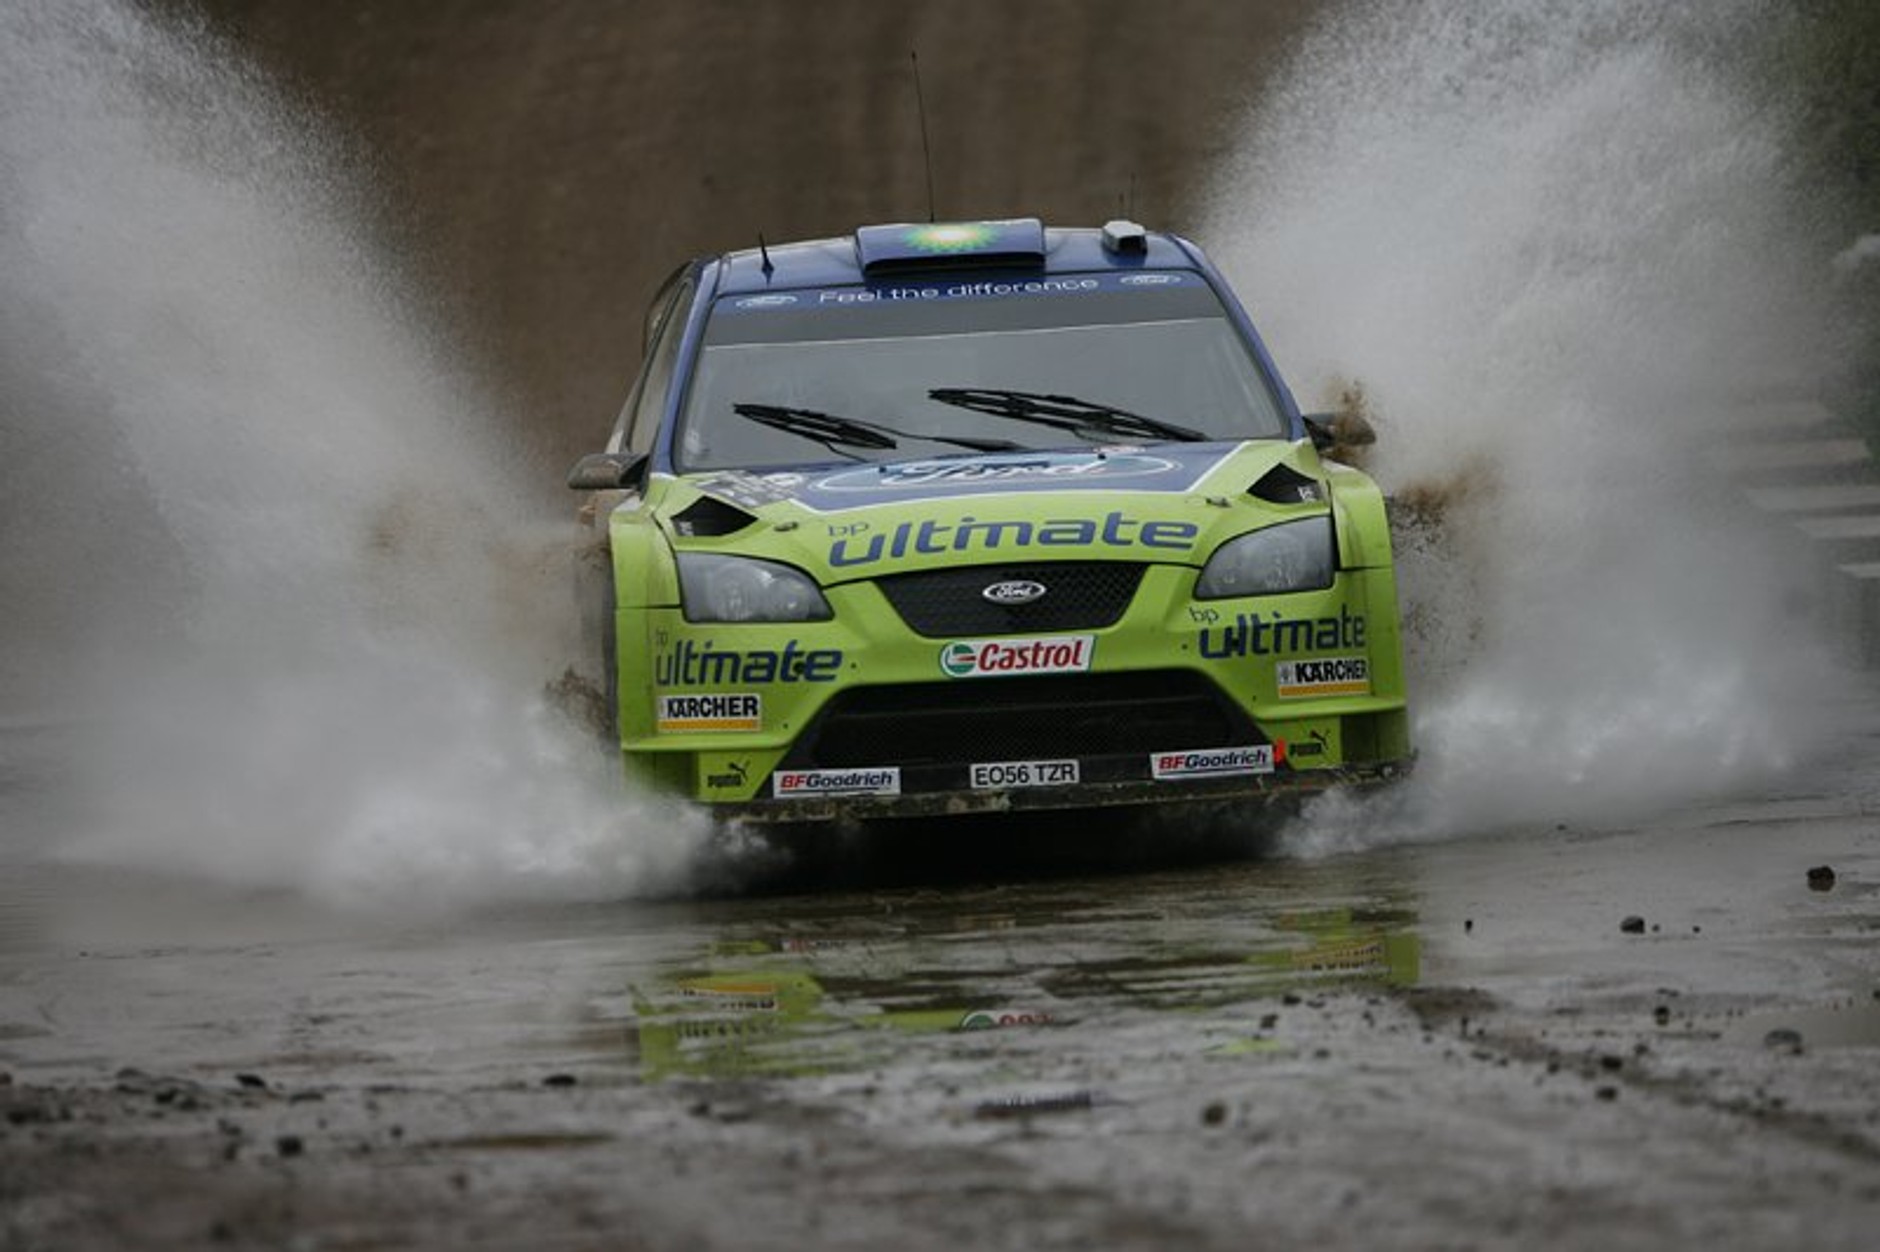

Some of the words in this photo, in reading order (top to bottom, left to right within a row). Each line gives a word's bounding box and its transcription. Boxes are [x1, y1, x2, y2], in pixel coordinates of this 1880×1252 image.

[819, 289, 882, 303] Feel
[889, 287, 939, 300] the
[947, 278, 1099, 298] difference
[881, 455, 1107, 485] Ford
[827, 522, 870, 538] bp
[828, 511, 1199, 567] ultimate
[1189, 607, 1219, 625] bp
[1199, 603, 1366, 659] ultimate
[656, 639, 843, 686] ultimate
[978, 640, 1083, 671] Castrol
[1159, 750, 1266, 769] BFGoodrich
[781, 771, 892, 788] BFGoodrich
[975, 764, 1030, 786] EO56
[1034, 763, 1076, 782] TZR
